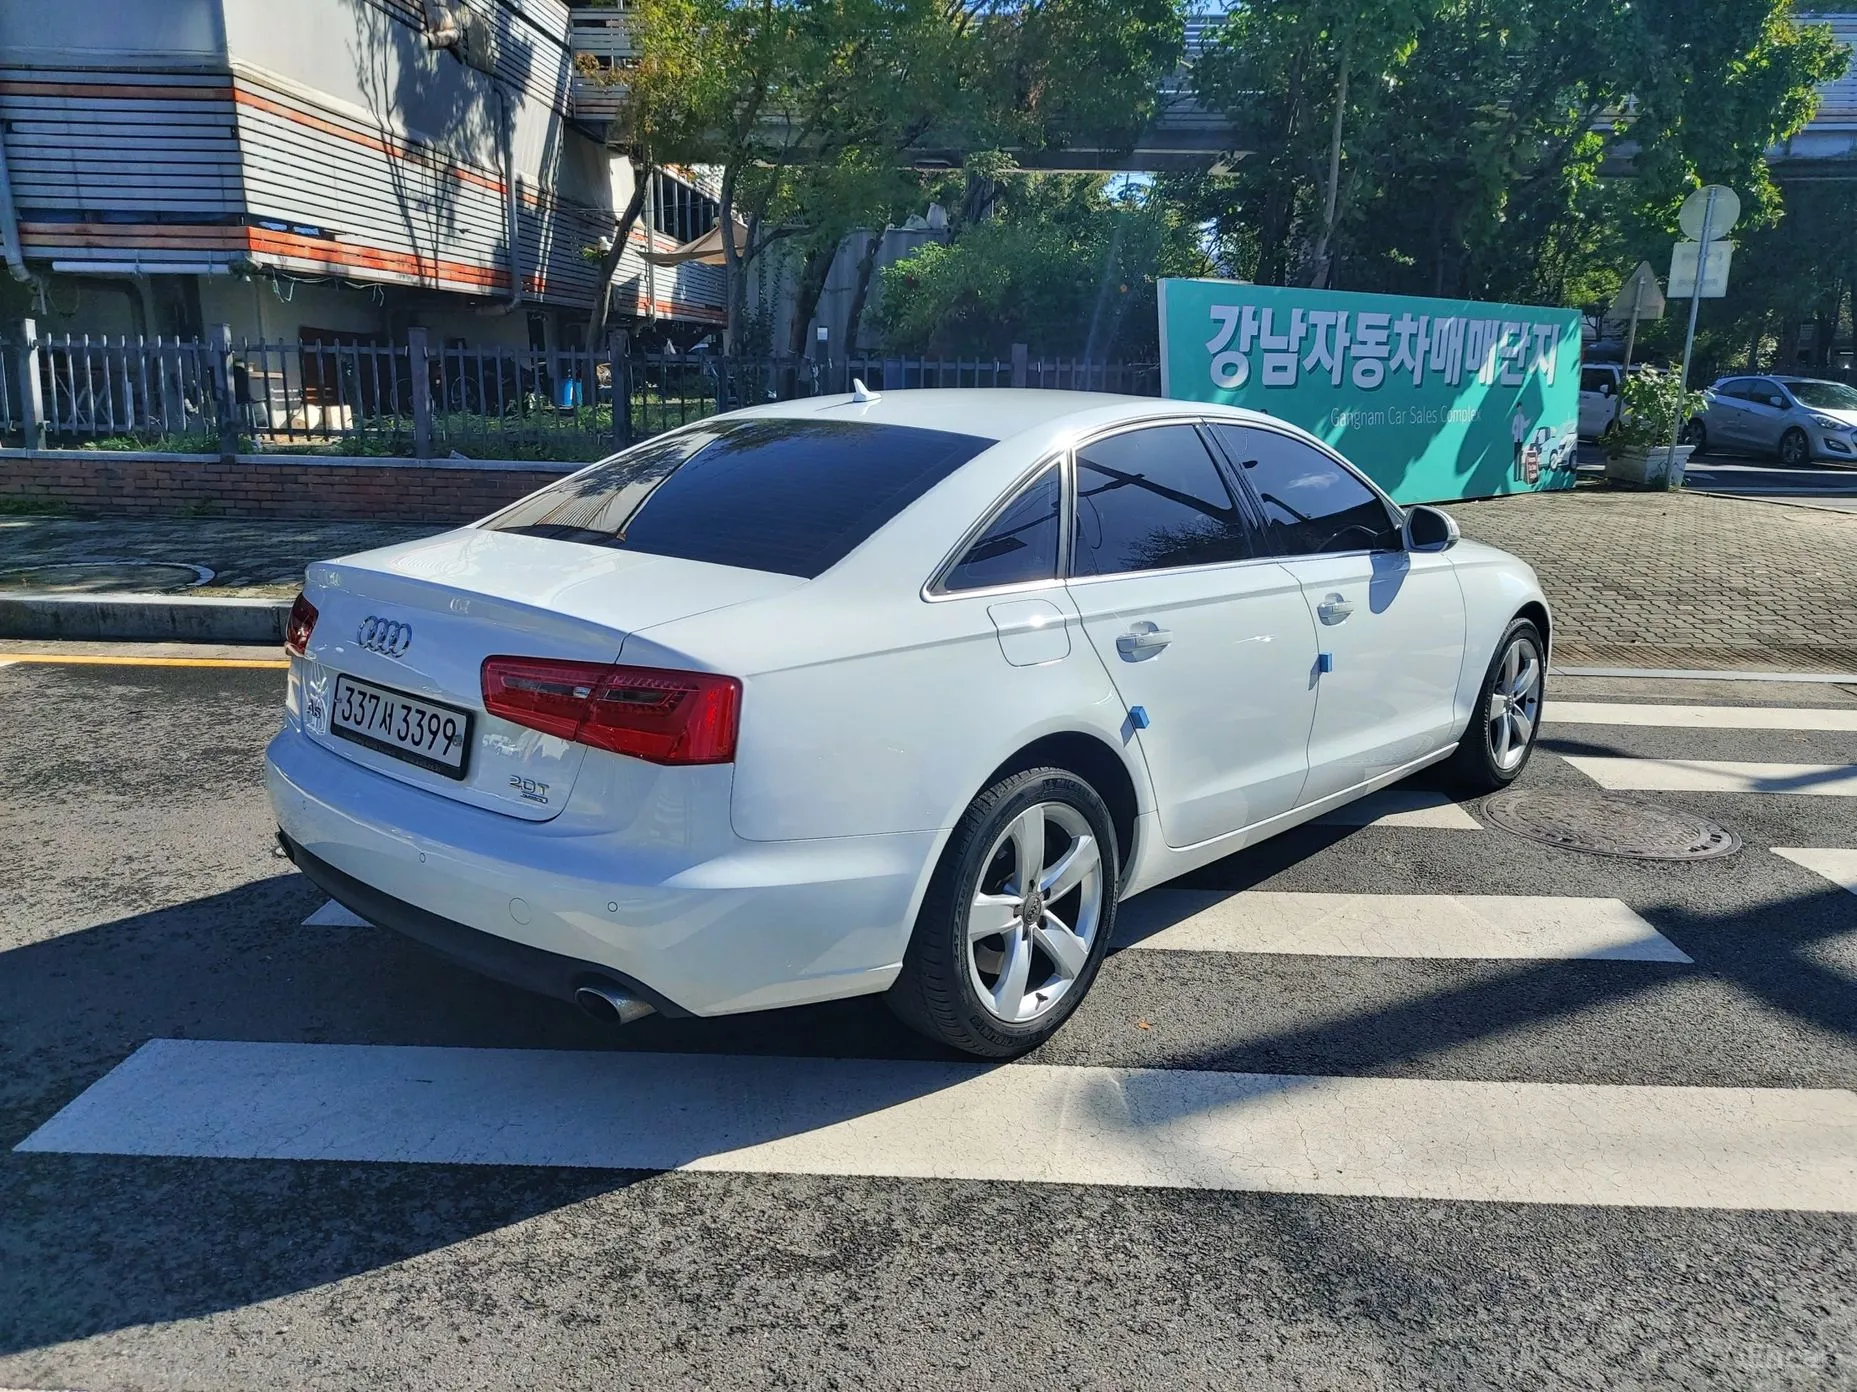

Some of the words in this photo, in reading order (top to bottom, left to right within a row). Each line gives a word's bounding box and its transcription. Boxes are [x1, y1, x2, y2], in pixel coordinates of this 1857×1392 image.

[1205, 303, 1560, 389] 강남자동차매매단지
[1330, 406, 1385, 430] Gangnam
[1387, 405, 1407, 425] Car
[1409, 405, 1438, 424] Sales
[1440, 404, 1482, 424] Complex
